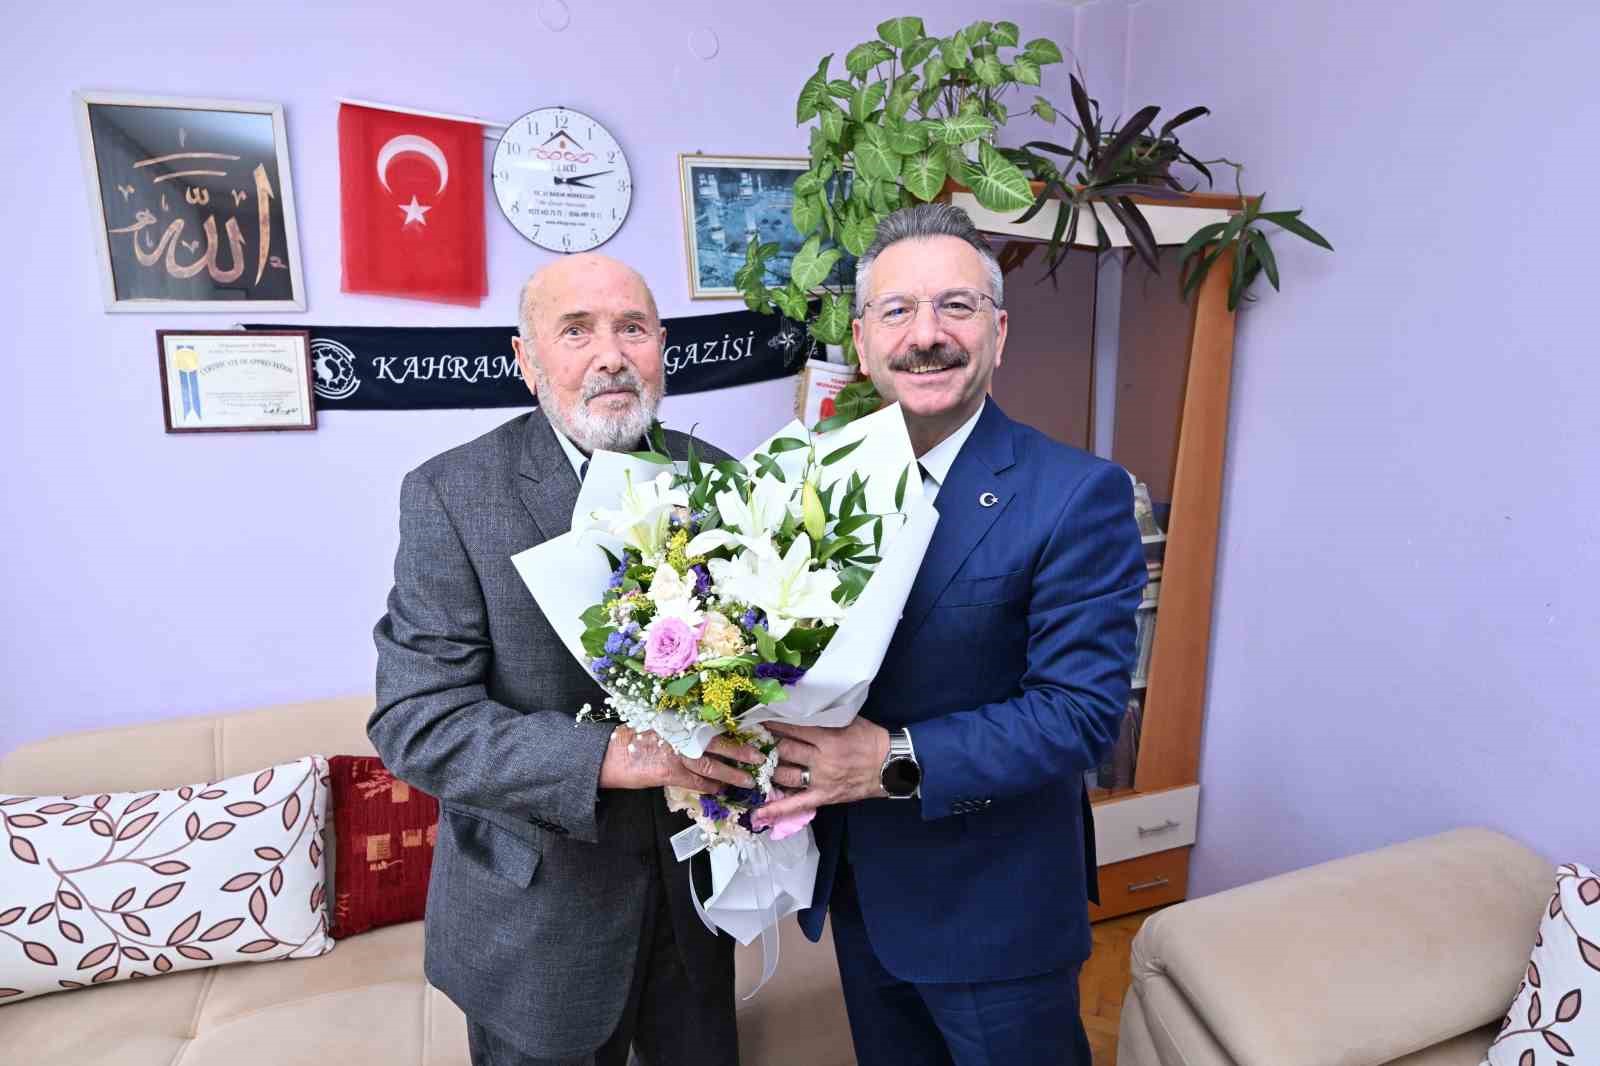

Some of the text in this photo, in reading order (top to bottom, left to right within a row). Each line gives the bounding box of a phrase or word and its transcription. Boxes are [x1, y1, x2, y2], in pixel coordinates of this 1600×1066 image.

[528, 121, 540, 136] 11
[554, 115, 569, 129] 12
[506, 141, 521, 155] 10
[606, 151, 616, 164] 2
[617, 178, 627, 193] 3
[510, 200, 520, 214] 8
[531, 224, 542, 241] 7
[561, 232, 572, 248] 6
[590, 228, 600, 244] 5
[373, 331, 754, 383] KAHRAM GAZİSİ
